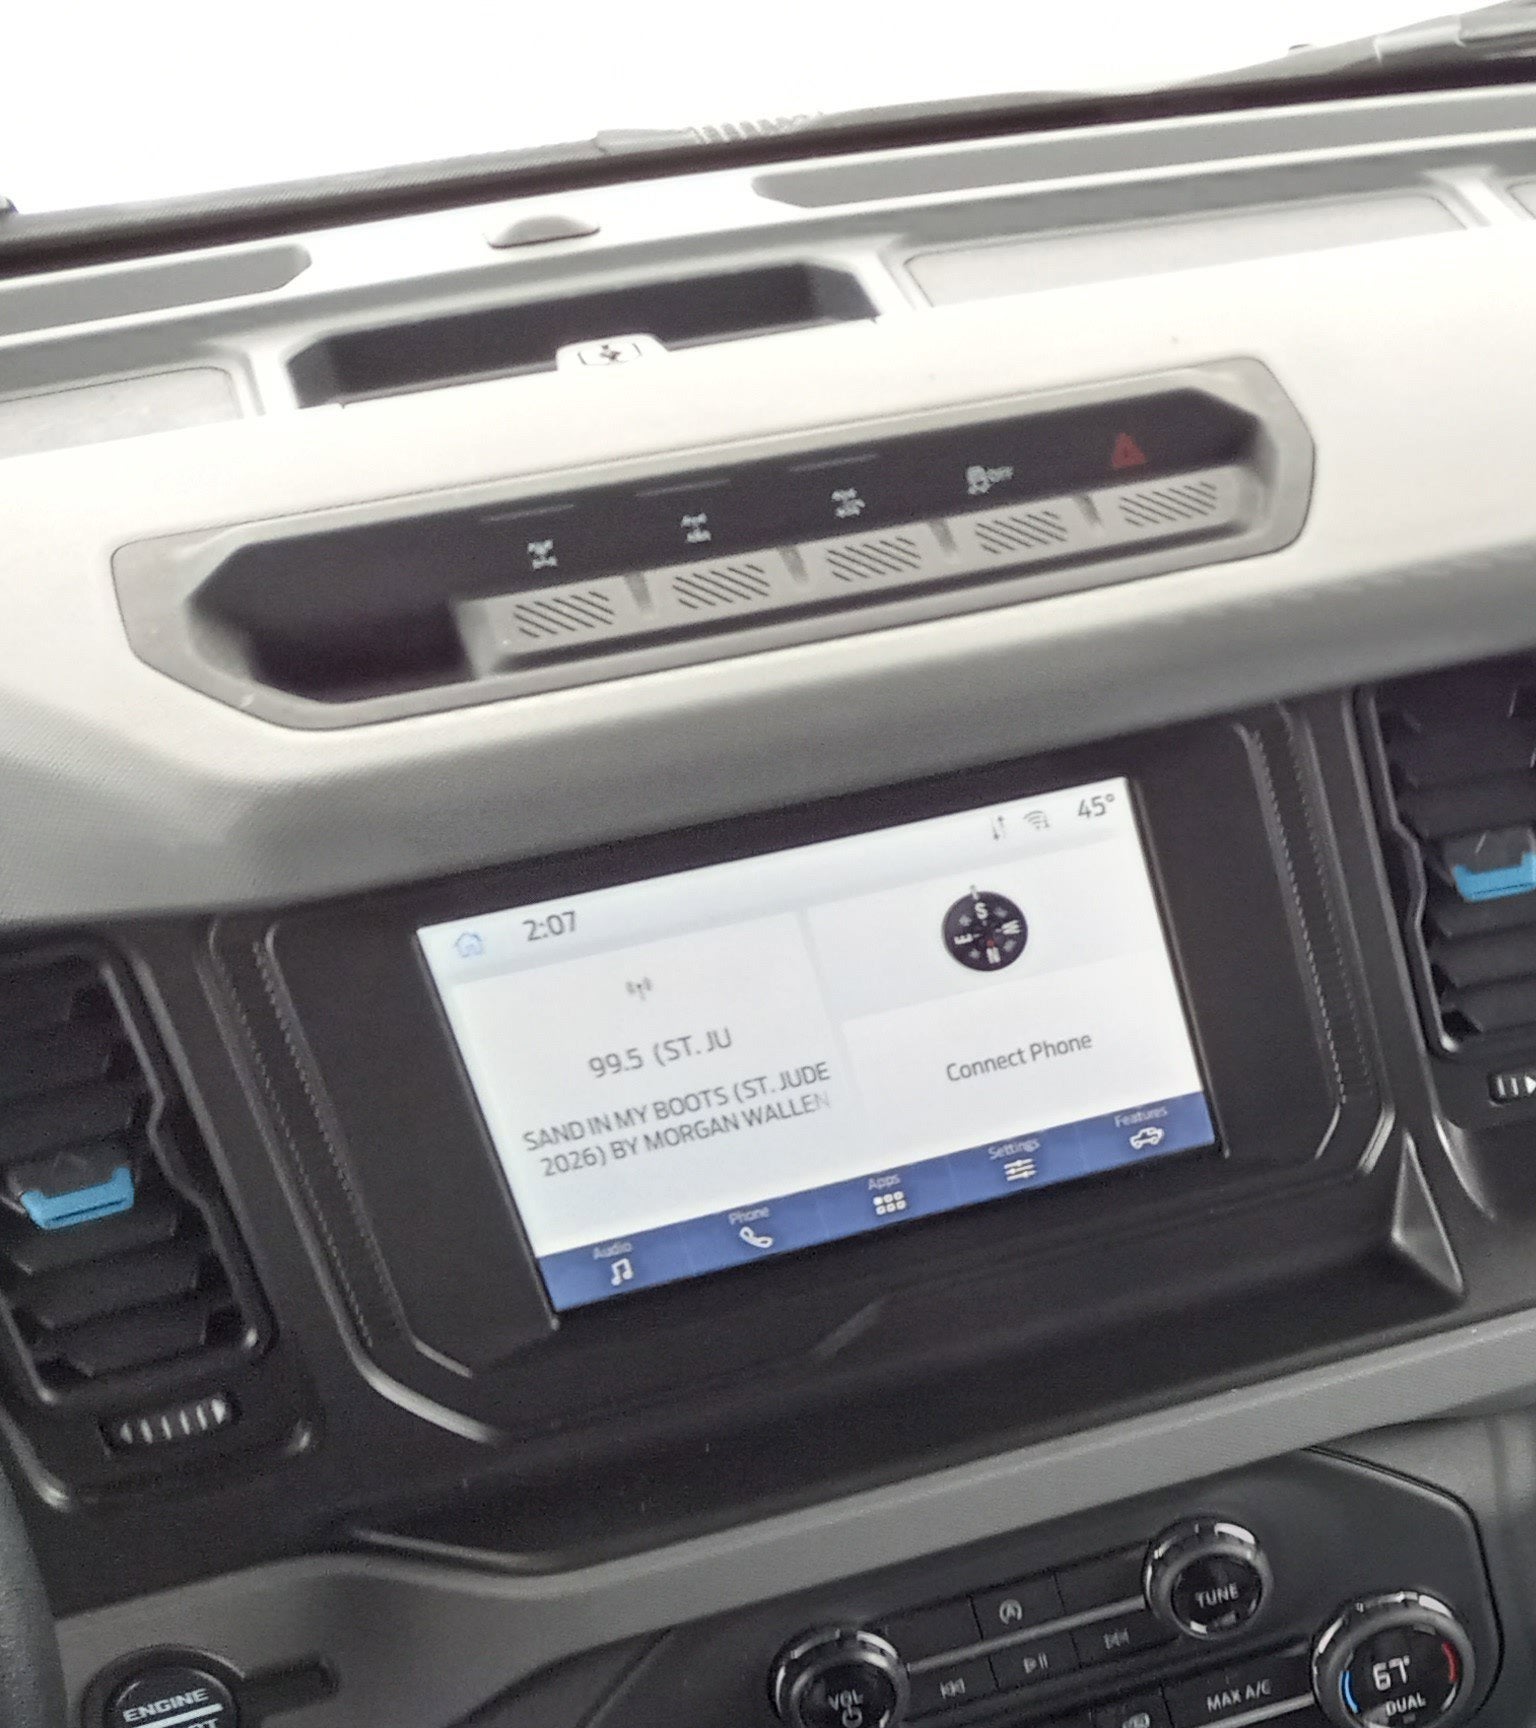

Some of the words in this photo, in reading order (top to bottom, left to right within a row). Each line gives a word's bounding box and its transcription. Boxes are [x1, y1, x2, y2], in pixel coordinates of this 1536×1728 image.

[522, 910, 580, 943] 2:07
[588, 1047, 644, 1078] 99.5
[652, 1034, 702, 1067] (ST.
[706, 1027, 733, 1052] JU
[946, 1047, 1027, 1082] Connect
[1029, 1033, 1093, 1062] Phone
[522, 1119, 585, 1151] SAND
[586, 1111, 613, 1136] IN
[614, 1103, 648, 1129] MY
[652, 1085, 728, 1120] BOOTS
[733, 1075, 777, 1104] (ST.
[778, 1061, 831, 1092] JUDE
[1114, 1105, 1169, 1128] Features
[540, 1145, 609, 1177] 2026)
[612, 1135, 640, 1161] BY
[643, 1111, 741, 1153] MORGAN
[987, 1137, 1041, 1161] Settings
[867, 1173, 902, 1192] Apps
[728, 1206, 770, 1226] Phone
[592, 1240, 634, 1261] Audio
[1196, 1582, 1239, 1607] TUNE
[122, 1688, 210, 1722] ENGINE
[1207, 1691, 1243, 1713] MAX
[1245, 1679, 1272, 1700] A/C
[1385, 1691, 1427, 1717] DUAL
